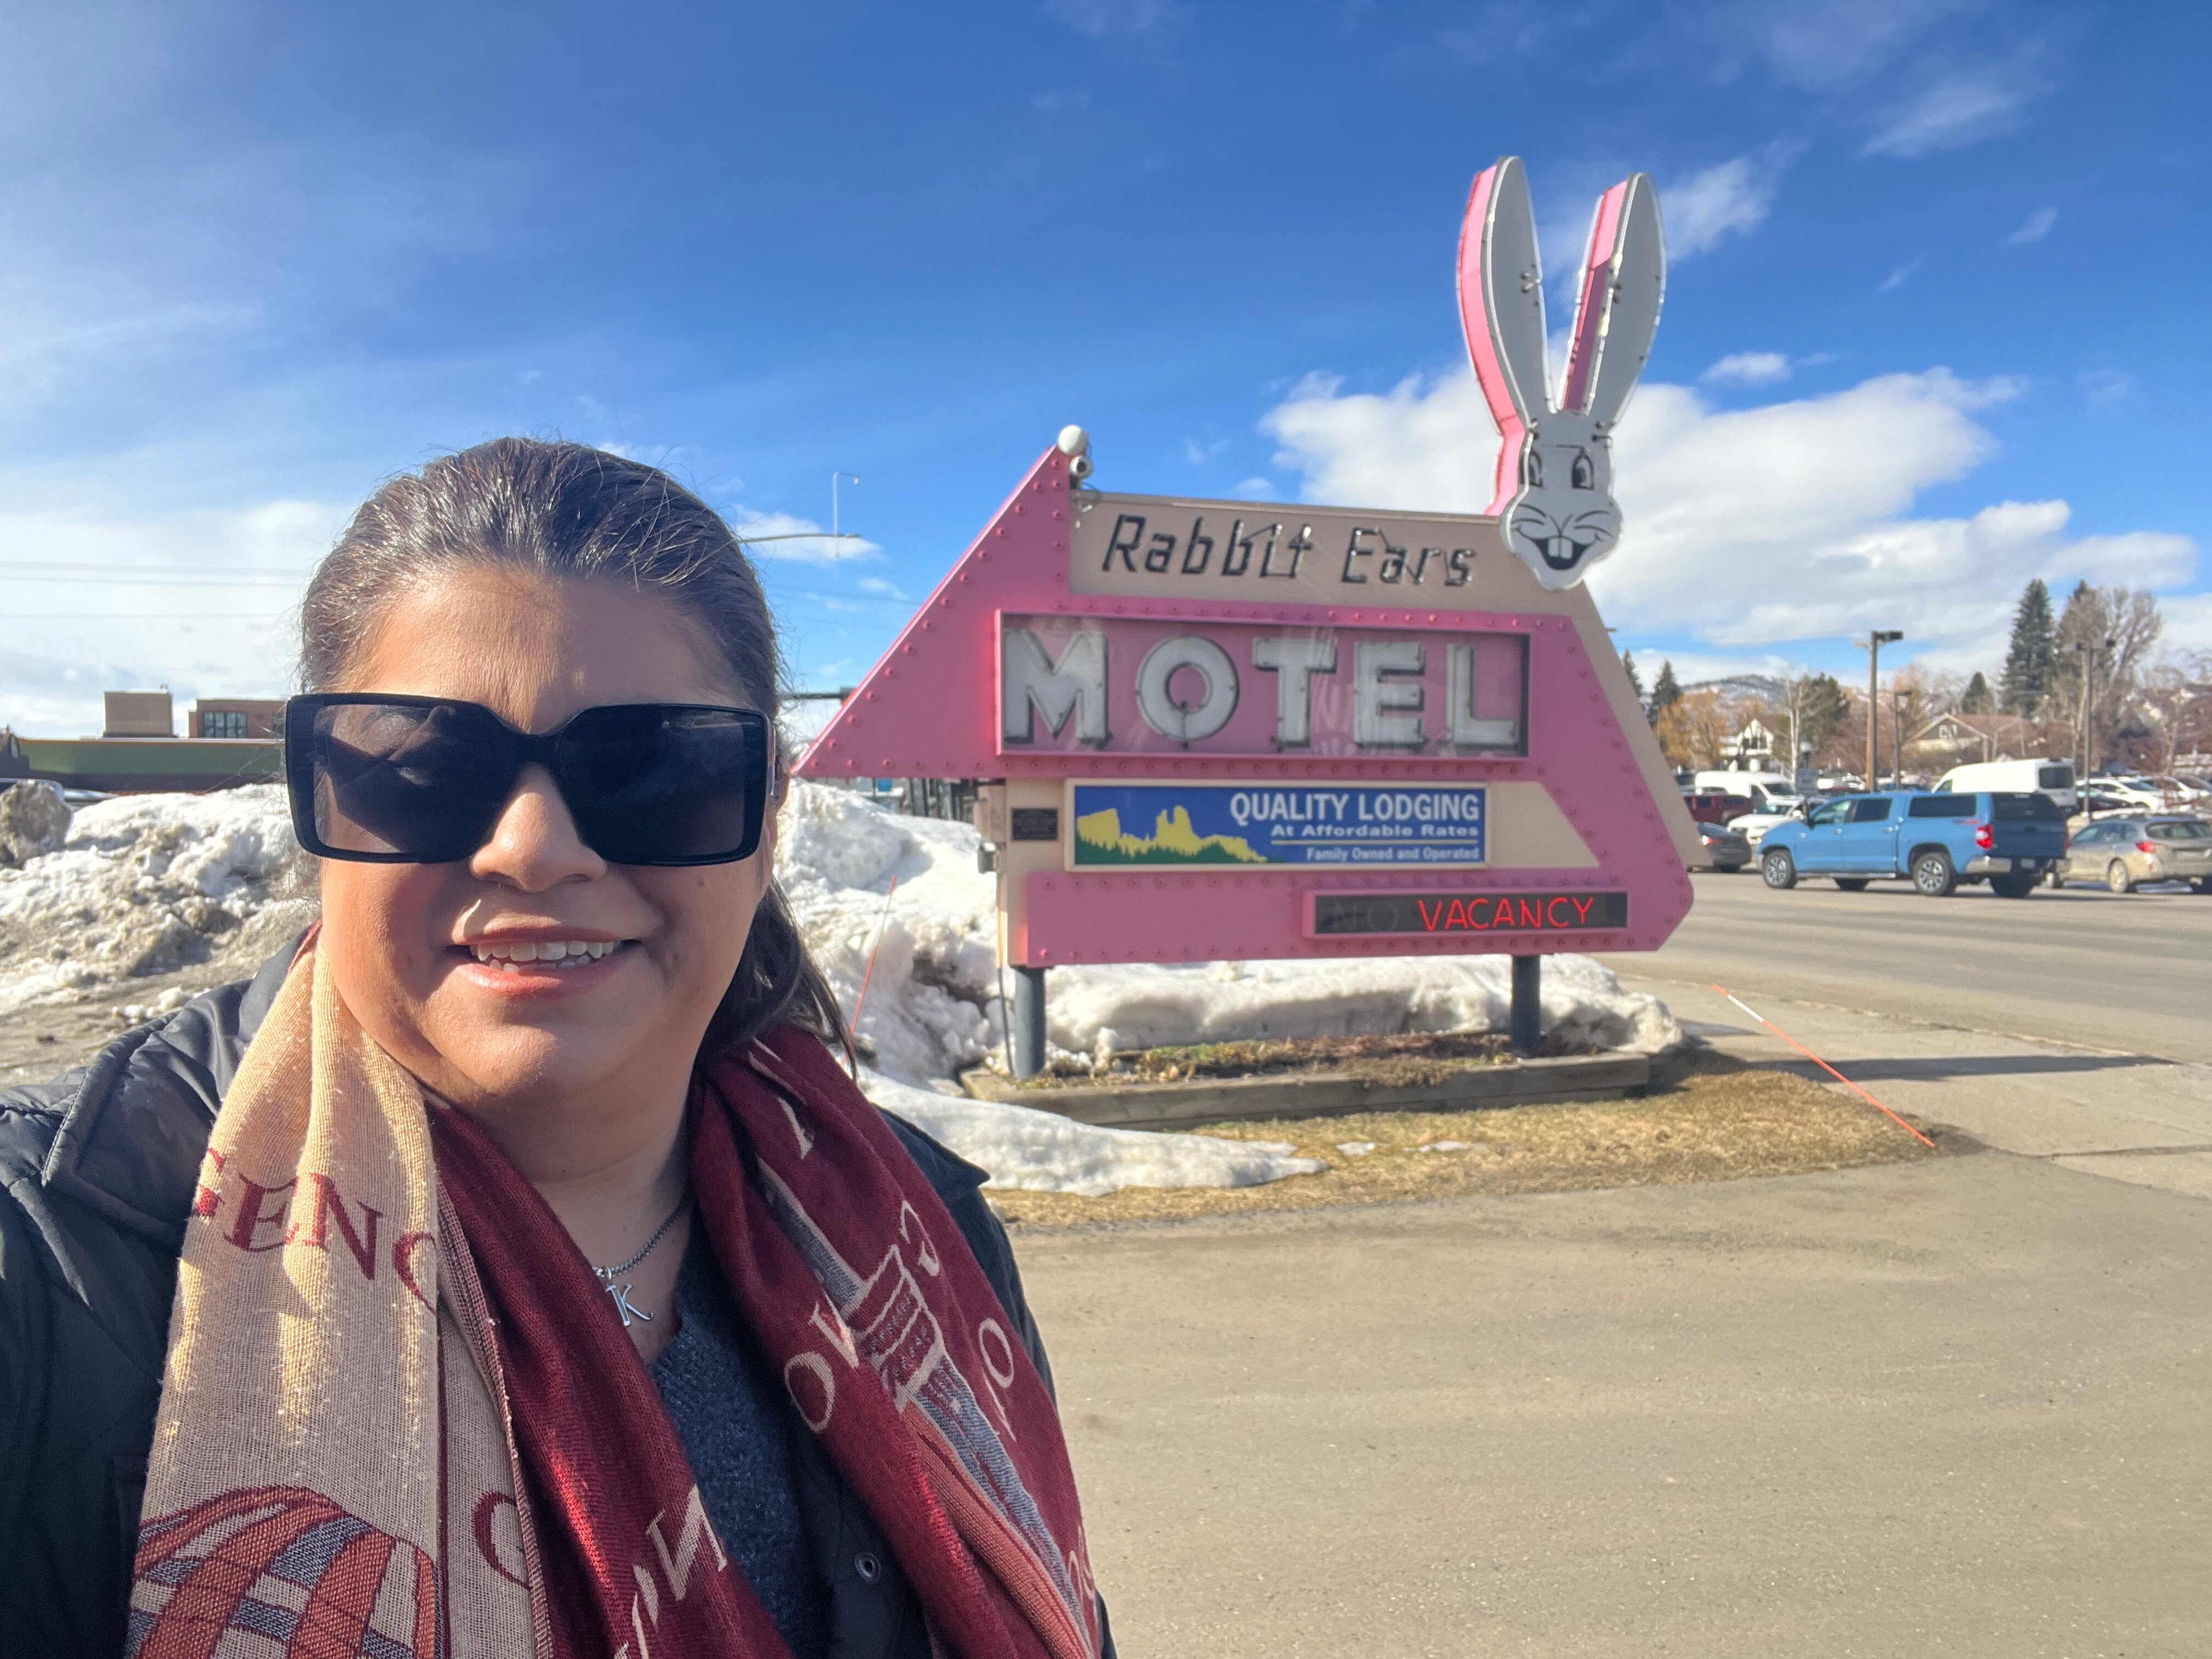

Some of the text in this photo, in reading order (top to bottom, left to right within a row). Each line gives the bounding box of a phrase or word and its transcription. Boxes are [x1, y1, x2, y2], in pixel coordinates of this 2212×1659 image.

[1102, 512, 1478, 587] Rabbit Ears
[1002, 627, 1521, 750] MOTEL
[1229, 792, 1480, 826] QUALITY LODGING
[1271, 823, 1479, 837] At Affordable Rates
[1307, 847, 1480, 862] Family Owned and Operated
[1417, 897, 1594, 931] VACANCY
